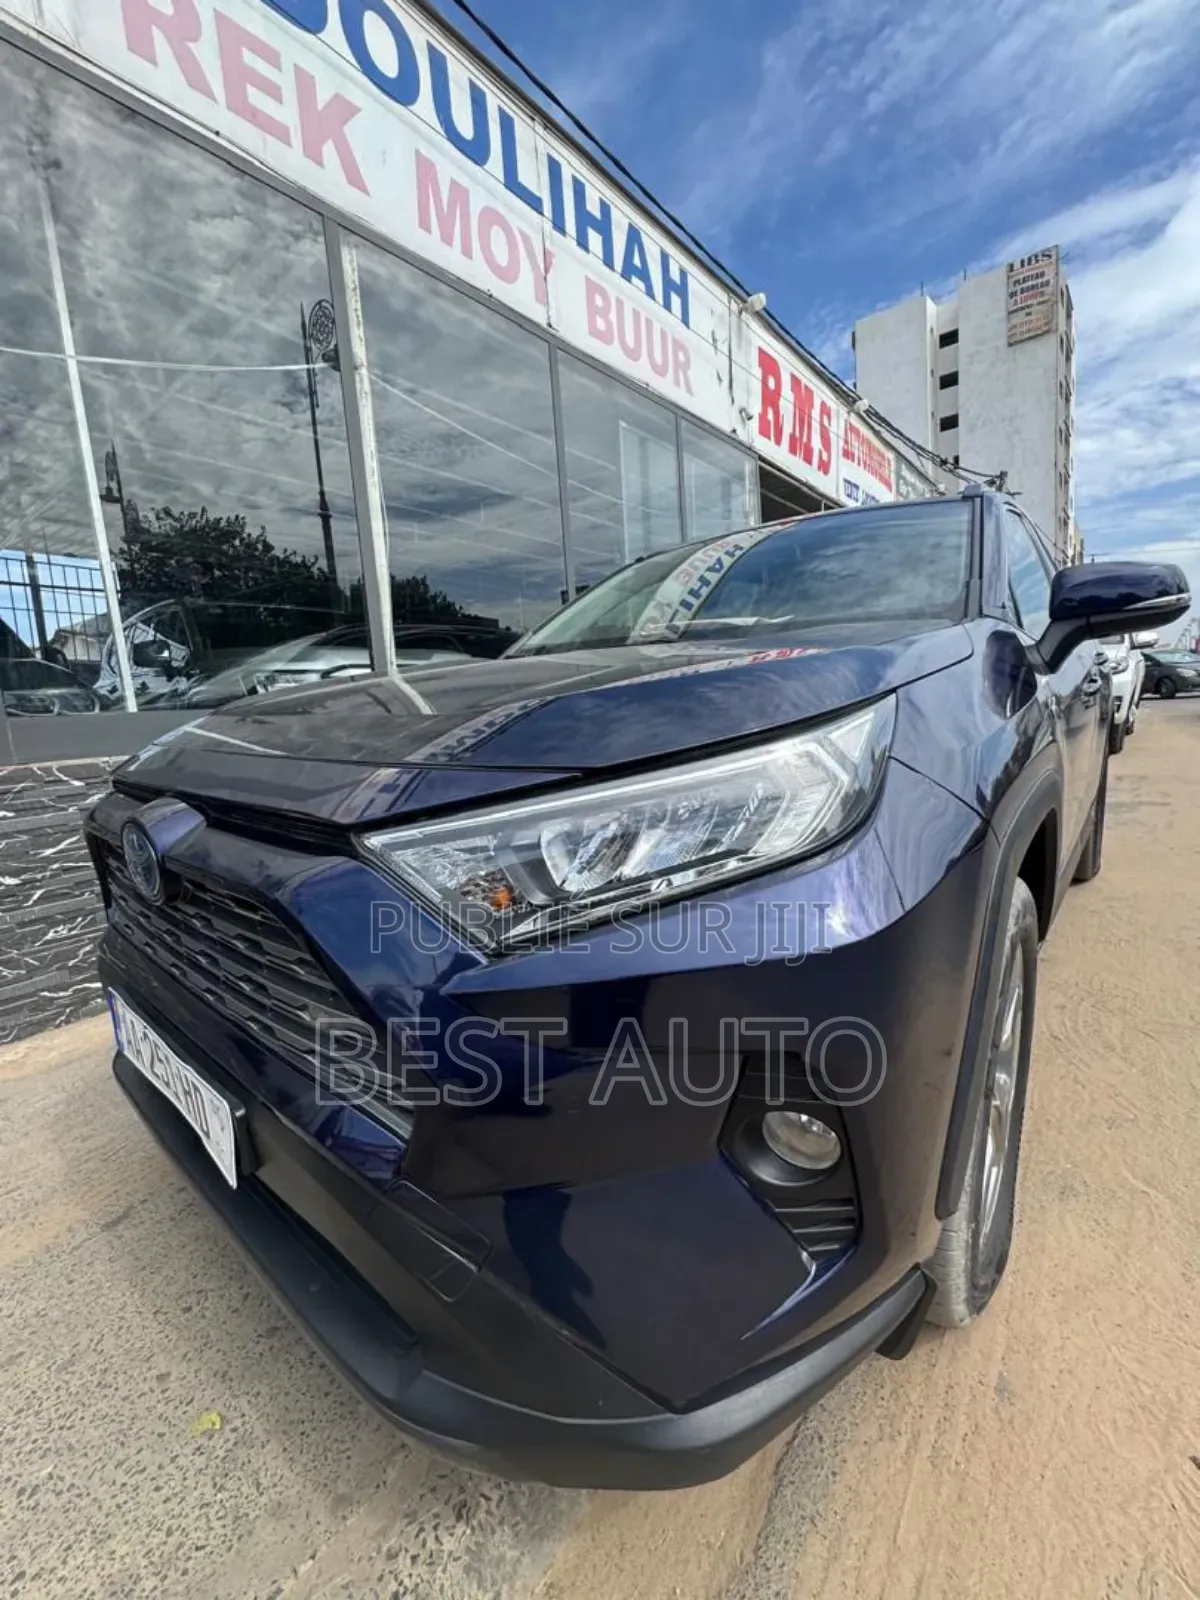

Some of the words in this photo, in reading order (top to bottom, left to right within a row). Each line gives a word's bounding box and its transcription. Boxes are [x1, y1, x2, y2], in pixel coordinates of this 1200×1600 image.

[122, 0, 370, 196] REK
[415, 149, 555, 306] MOY
[585, 275, 693, 396] BUUR
[757, 346, 832, 477] RMS
